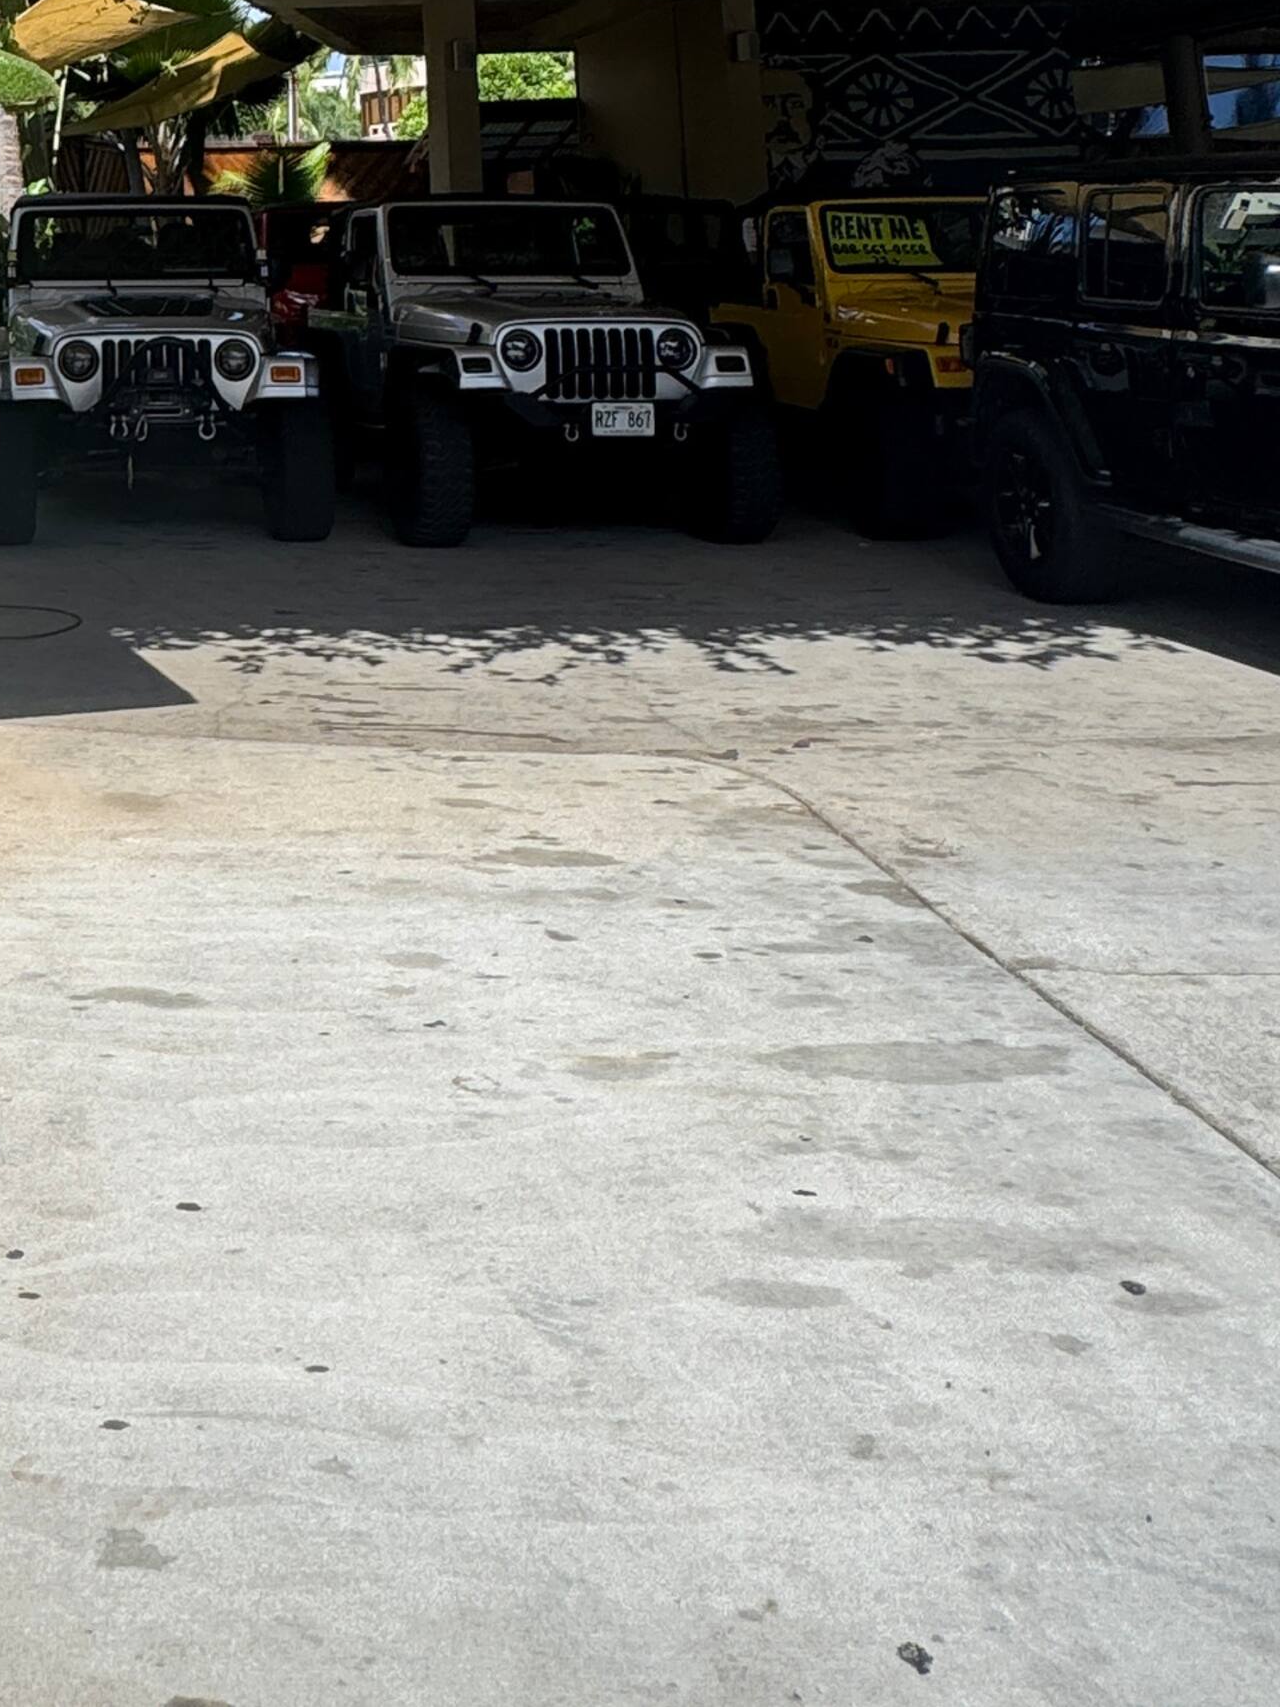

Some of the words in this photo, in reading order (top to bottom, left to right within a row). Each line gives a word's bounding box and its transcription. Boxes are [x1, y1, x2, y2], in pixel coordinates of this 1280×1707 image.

[831, 214, 882, 240] RENT
[888, 216, 924, 240] ME
[595, 410, 619, 428] RZF
[627, 410, 651, 429] 867
